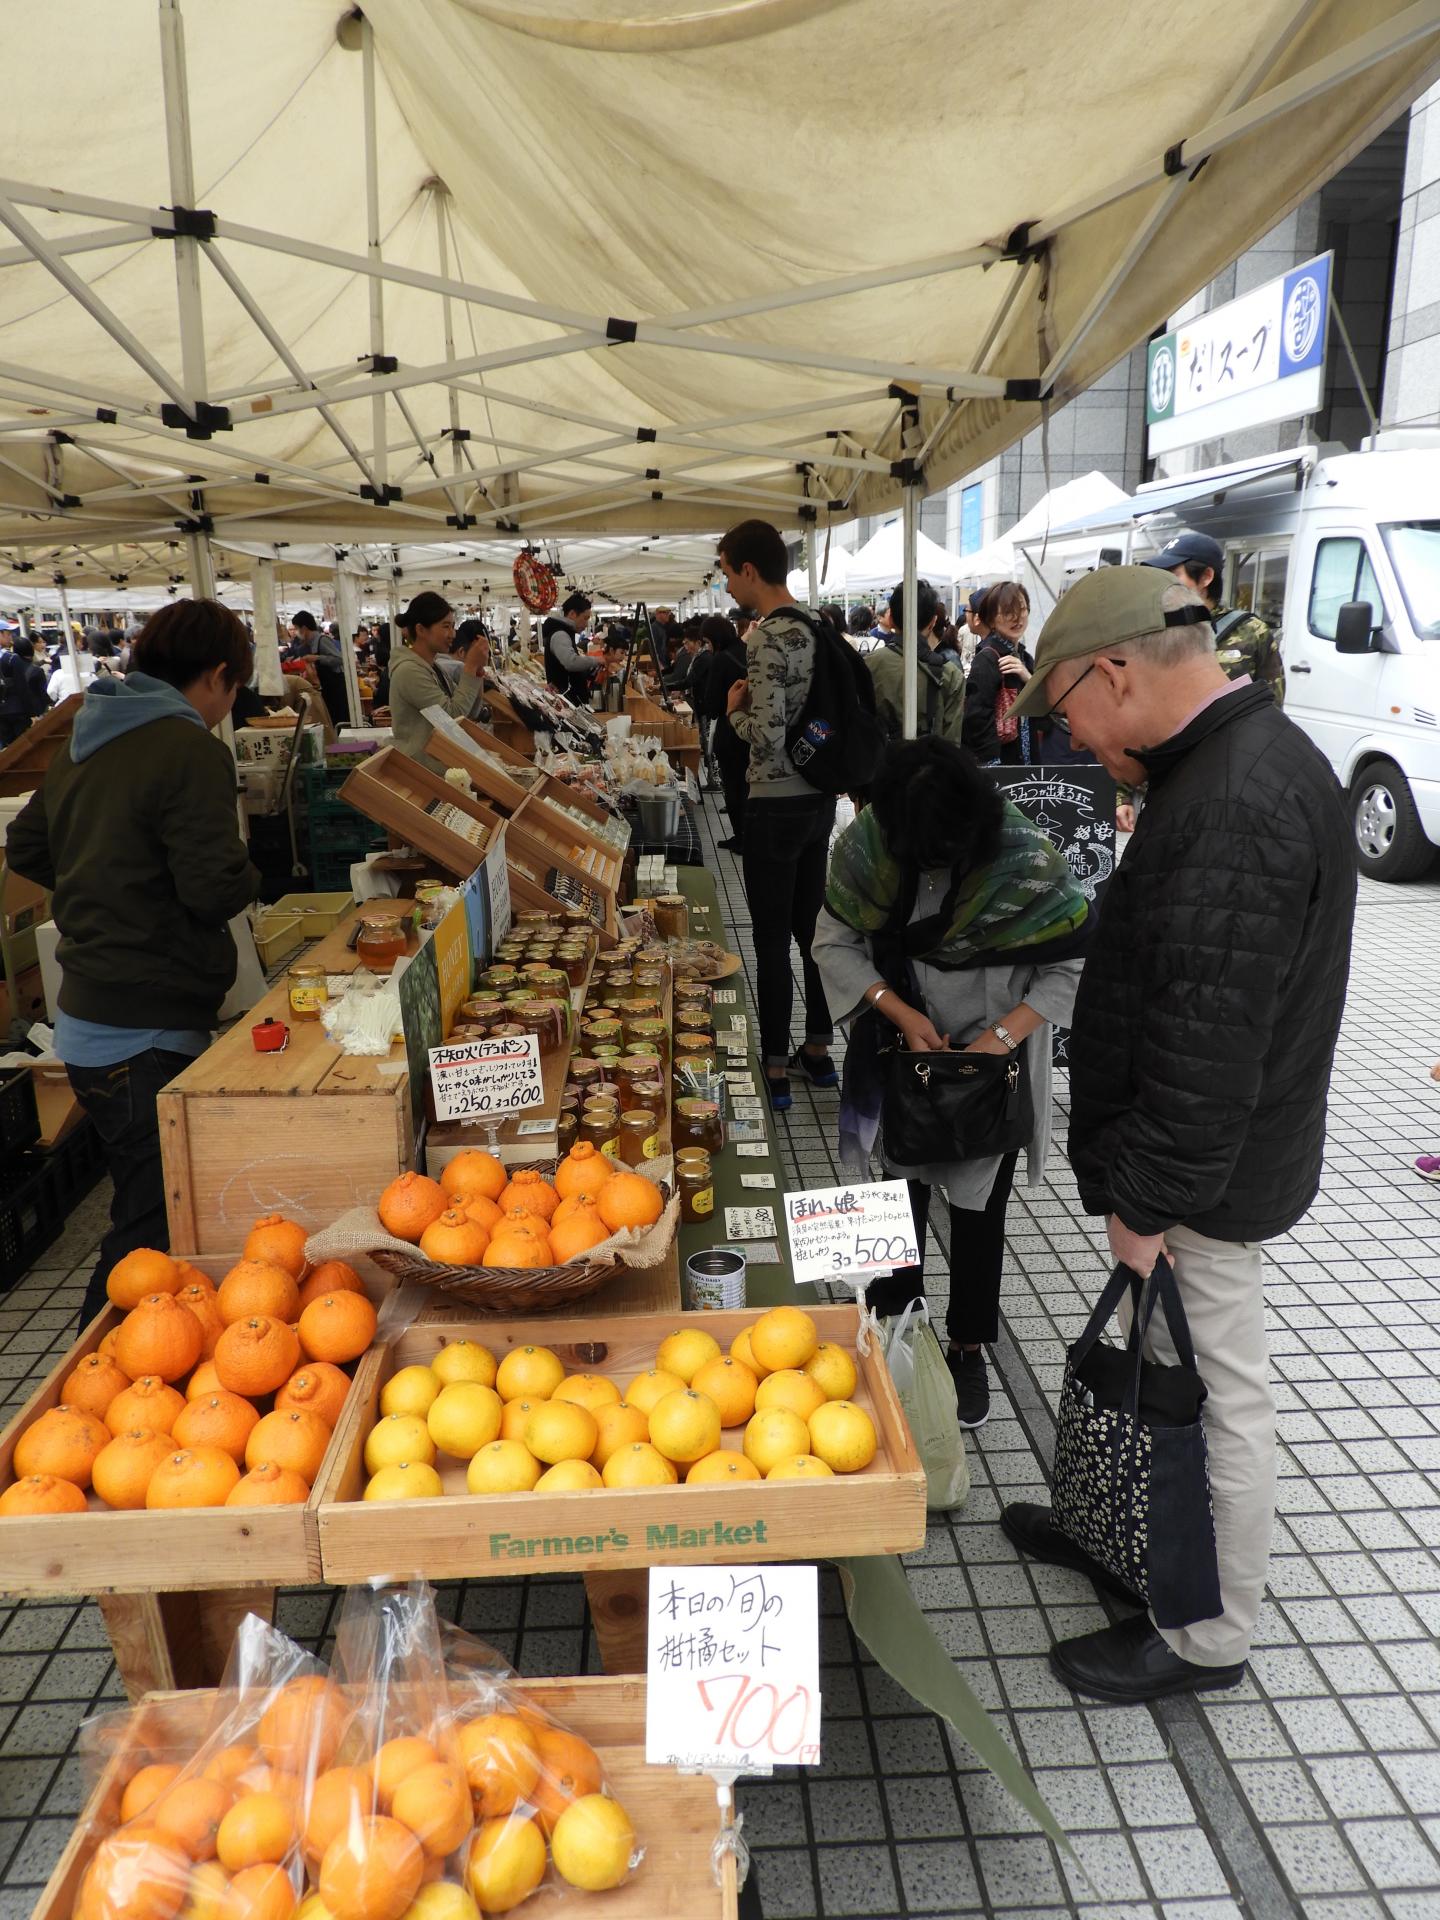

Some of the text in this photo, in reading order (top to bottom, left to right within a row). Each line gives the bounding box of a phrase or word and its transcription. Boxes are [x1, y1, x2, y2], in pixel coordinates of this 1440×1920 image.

[1008, 782, 1092, 804] ちみつが出来るまで
[1068, 864, 1093, 876] ONEY
[489, 1519, 768, 1560] Farmer's Market
[657, 1574, 784, 1633] 本日の旬の
[657, 1625, 782, 1672] 柑橘セット
